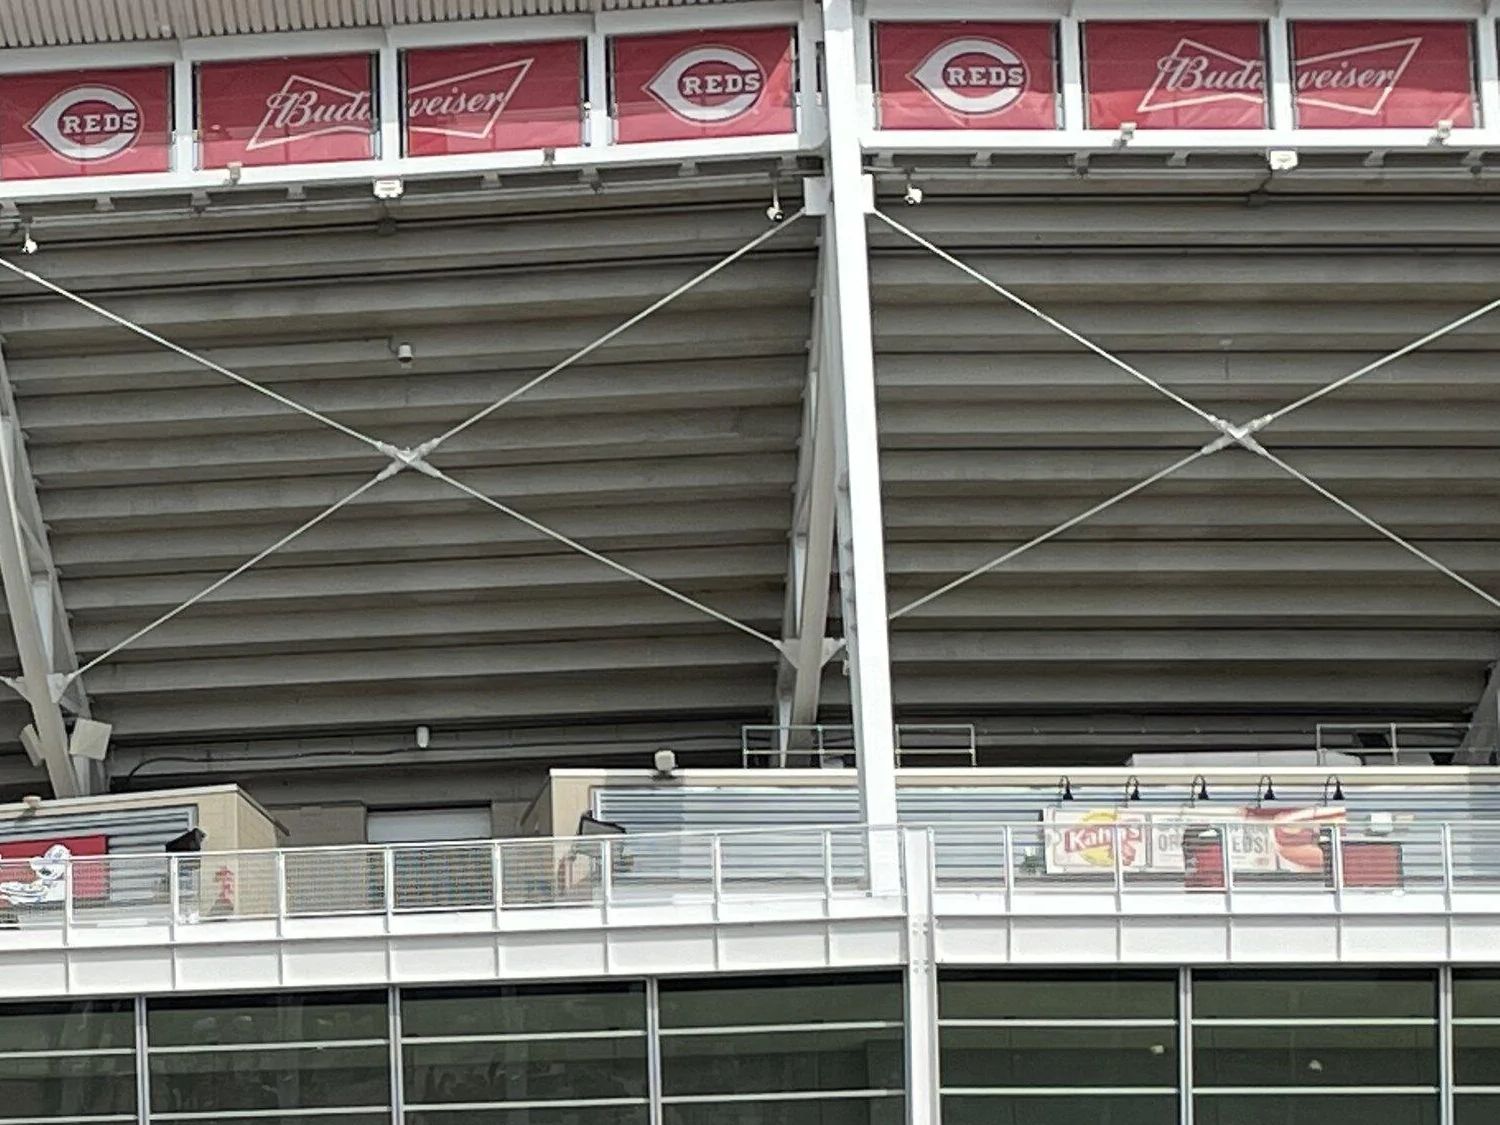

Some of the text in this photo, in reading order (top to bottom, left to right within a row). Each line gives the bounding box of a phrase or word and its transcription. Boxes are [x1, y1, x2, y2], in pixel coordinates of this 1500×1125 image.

[680, 73, 764, 96] REDS
[947, 64, 1027, 88] REDS
[63, 110, 138, 134] REDS
